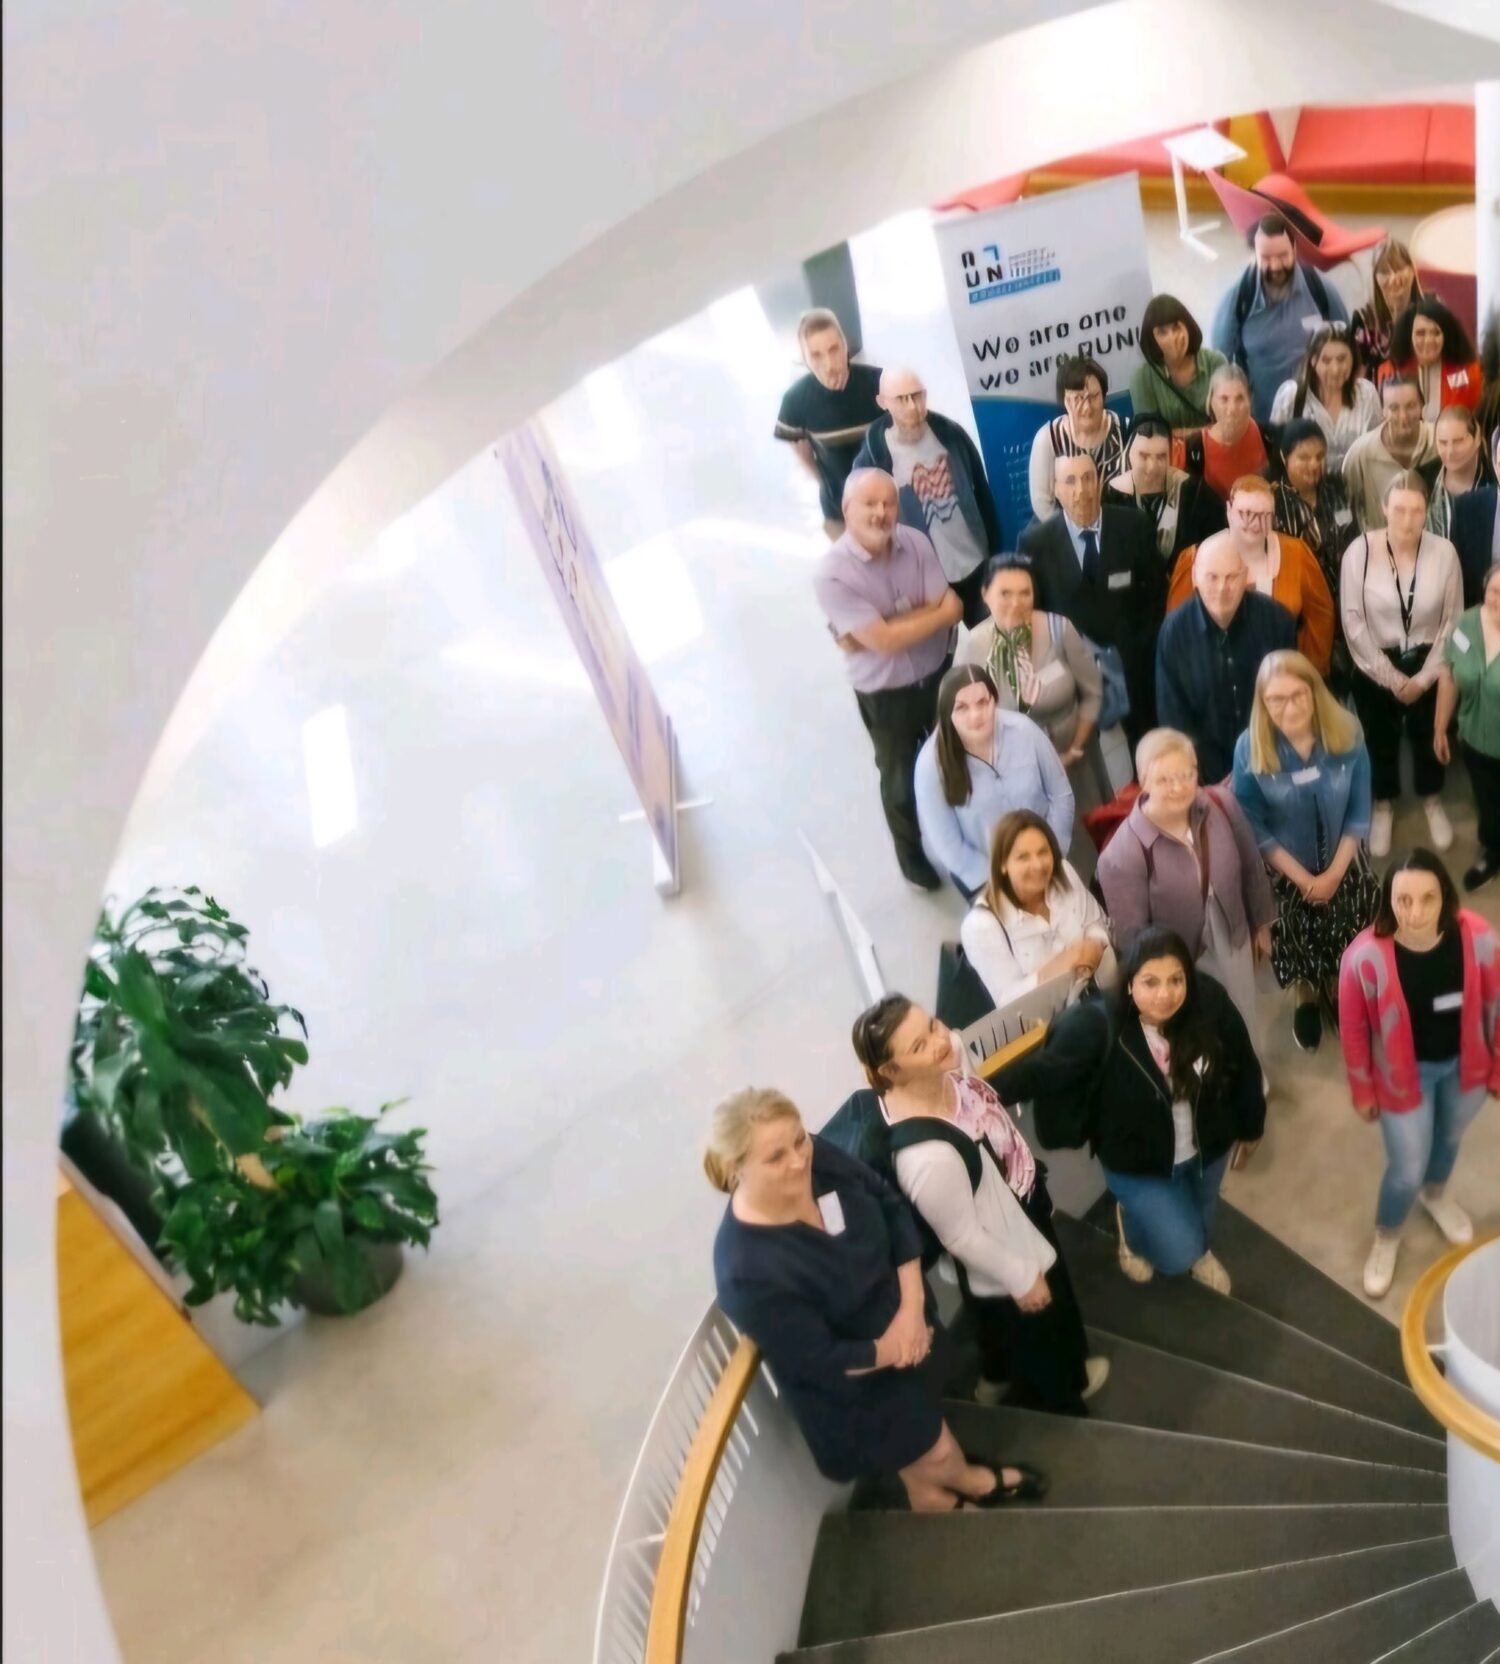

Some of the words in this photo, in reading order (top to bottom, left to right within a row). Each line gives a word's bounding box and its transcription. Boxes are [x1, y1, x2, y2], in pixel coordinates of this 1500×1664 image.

[972, 336, 1020, 361] We
[1029, 322, 1070, 347] are
[1079, 305, 1126, 331] one
[980, 368, 1020, 390] we
